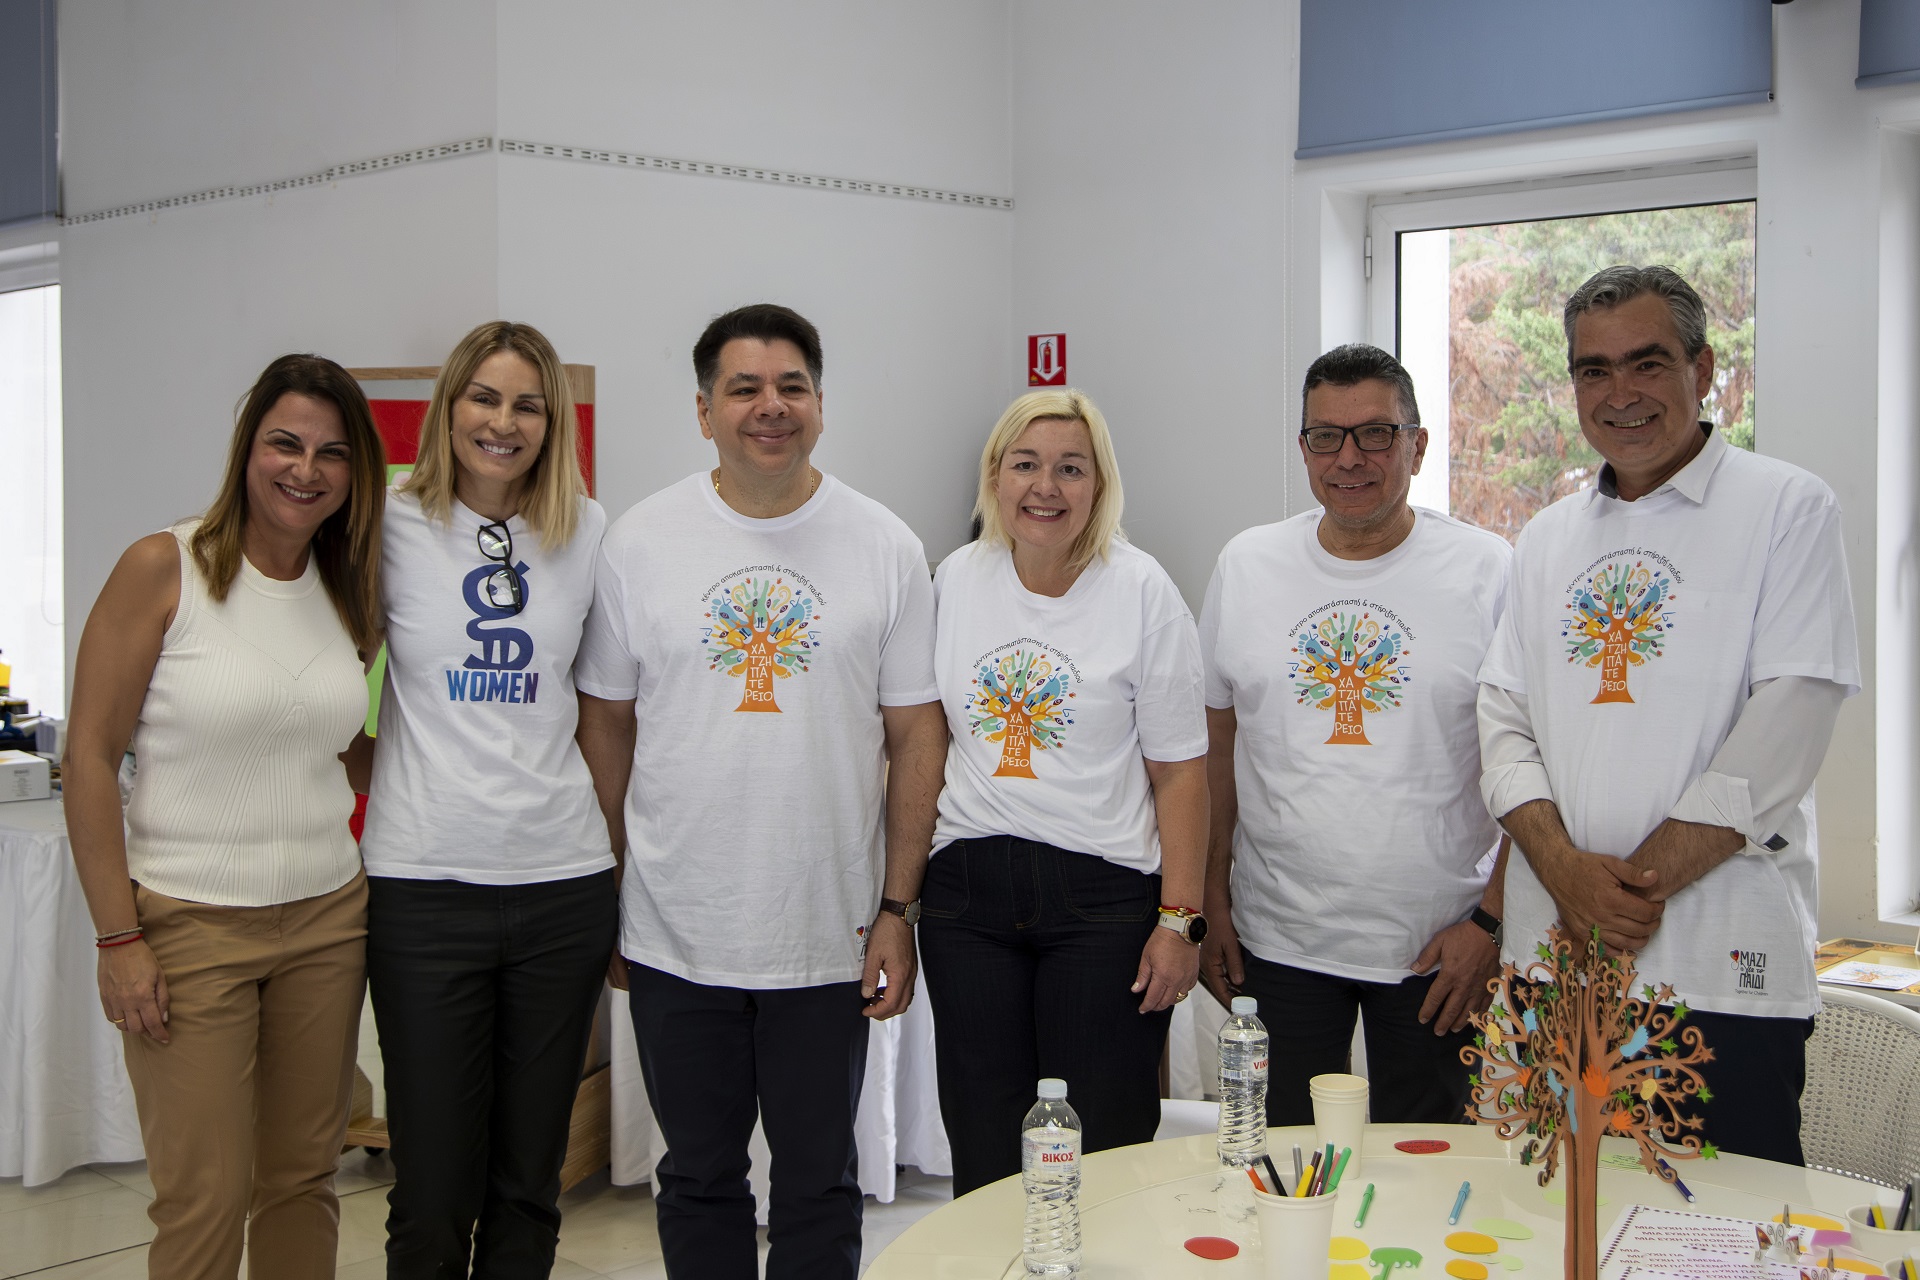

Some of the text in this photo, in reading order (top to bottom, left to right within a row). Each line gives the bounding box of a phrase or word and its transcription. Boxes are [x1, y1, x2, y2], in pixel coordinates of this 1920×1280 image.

[1636, 547, 1642, 555] &
[776, 564, 781, 572] &
[1362, 599, 1368, 607] &
[1608, 630, 1623, 643] ΧΑ
[751, 643, 766, 655] ΧΑ
[1606, 643, 1627, 655] ΤΖΗ
[750, 655, 772, 667] ΤΖΗ
[1606, 654, 1623, 668] ΠΑ
[750, 666, 768, 679] ΠΑ
[1604, 668, 1618, 679] ΤΕ
[446, 669, 539, 704] WOMEN
[748, 679, 764, 689] ΤΕ
[1338, 676, 1354, 689] ΧΑ
[1600, 679, 1626, 694] ΡΕΙΟ
[744, 688, 773, 703] ΡΕΙΟ
[1338, 689, 1360, 701] ΤΖΗ
[1338, 700, 1357, 712] ΠΑ
[1009, 712, 1023, 724] ΧΑ
[1338, 712, 1353, 722] ΤΕ
[1008, 724, 1029, 737] ΤΖΗ
[1334, 722, 1363, 736] ΡΕΙΟ
[1008, 735, 1026, 748] ΠΑ
[1006, 746, 1021, 757] ΤΕ
[1000, 755, 1030, 769] ΡΕΙΟ
[1740, 950, 1766, 968] ΜΑΖΙ
[1739, 972, 1764, 989] ΠΑΙΔΙ
[1041, 1151, 1074, 1163] ΒΙΚΟΣ
